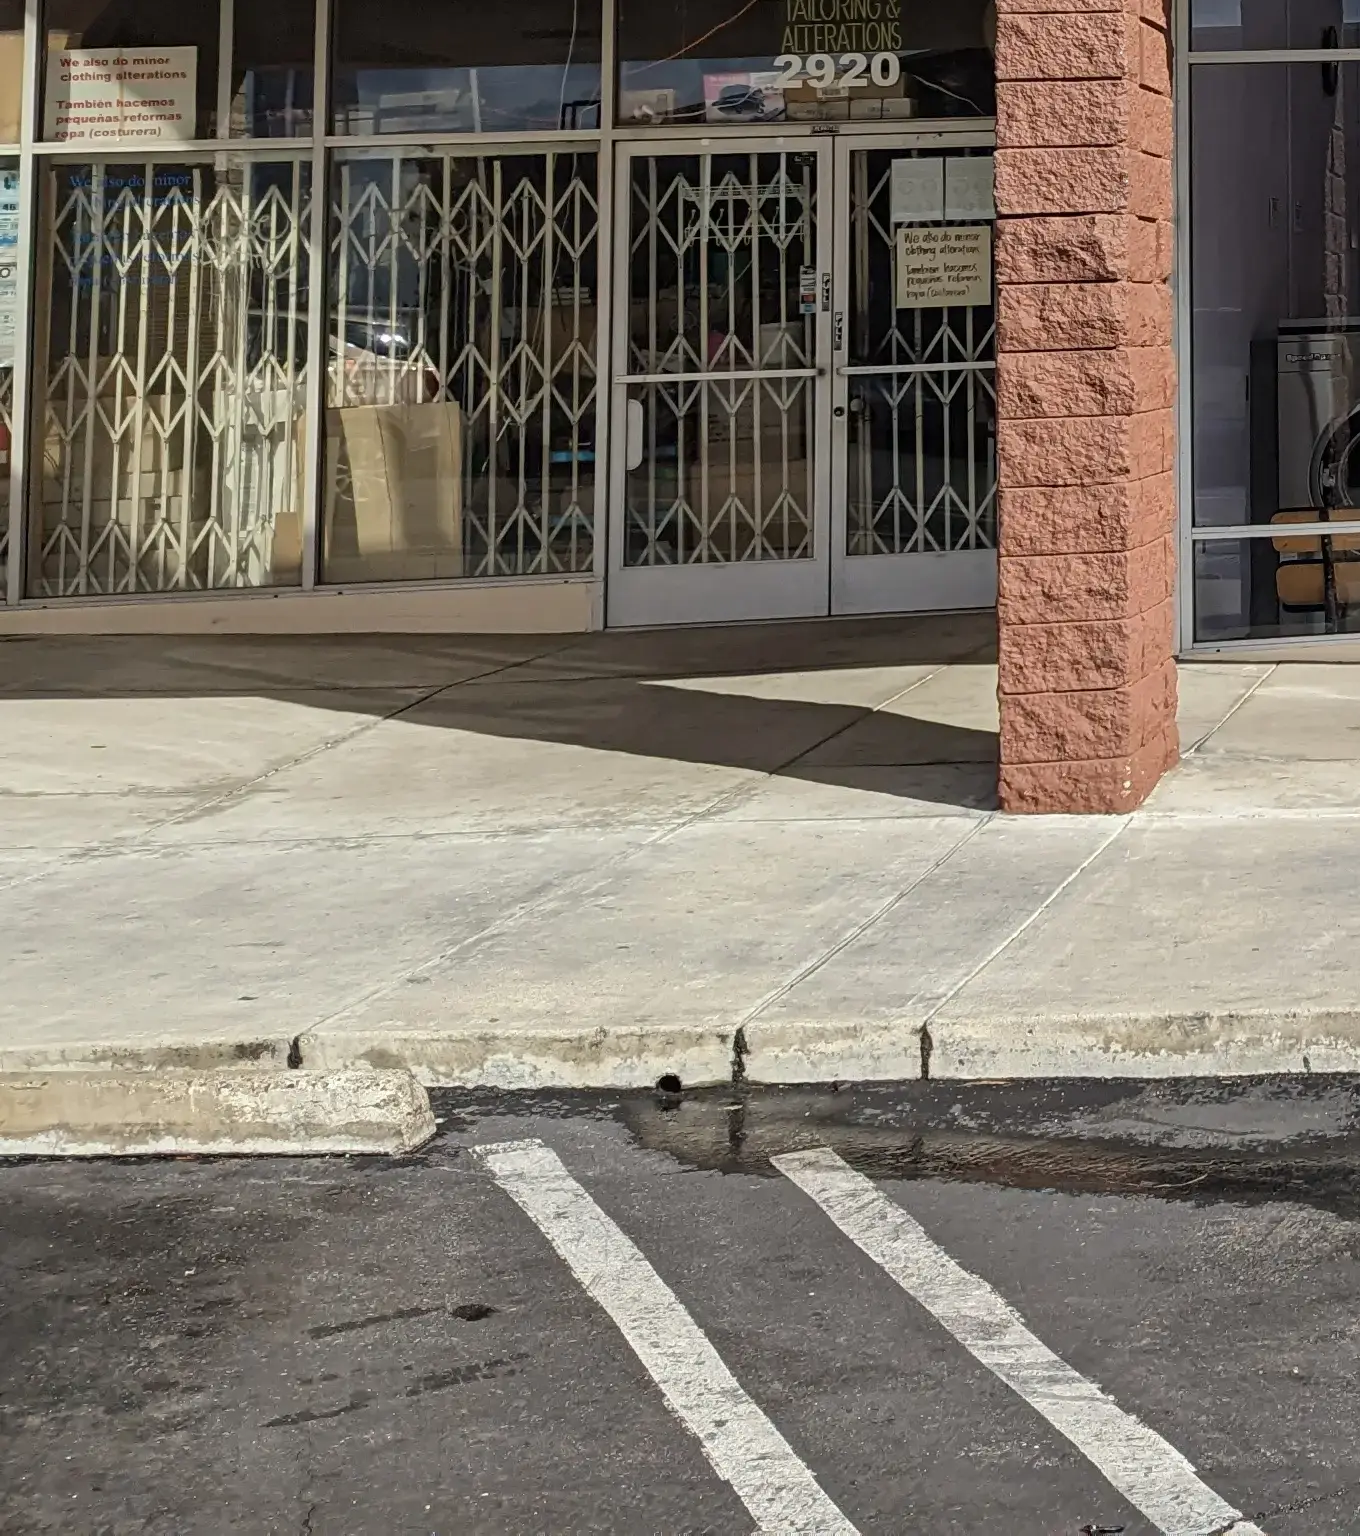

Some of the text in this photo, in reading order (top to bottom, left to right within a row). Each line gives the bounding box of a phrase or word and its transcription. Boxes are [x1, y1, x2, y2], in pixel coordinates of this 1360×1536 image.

[781, 22, 902, 53] ALTERATIONS
[60, 56, 170, 67] We also do minor
[60, 70, 187, 82] clothing alterations
[773, 52, 900, 89] 2920
[56, 98, 175, 109] También hacemos
[56, 112, 182, 125] pequeñas reformas
[55, 127, 162, 140] ropa (costurera)
[904, 232, 919, 243] We
[940, 231, 951, 242] do
